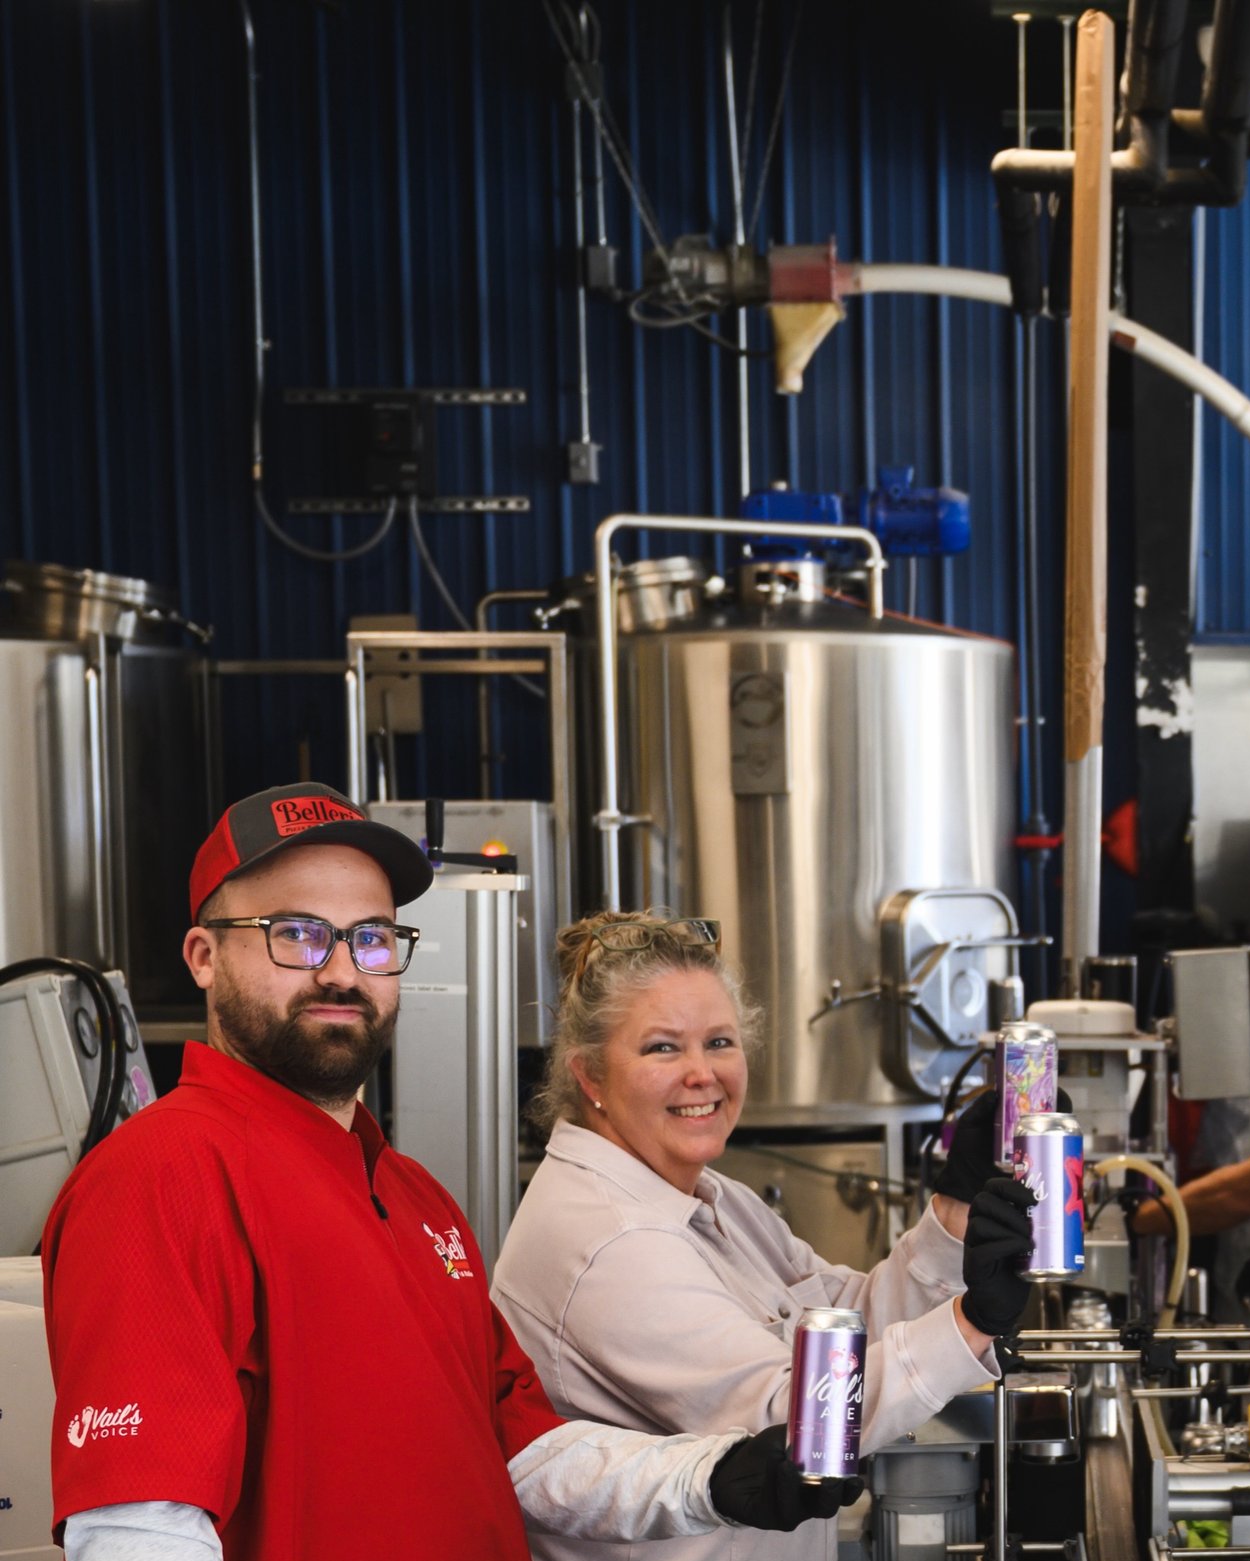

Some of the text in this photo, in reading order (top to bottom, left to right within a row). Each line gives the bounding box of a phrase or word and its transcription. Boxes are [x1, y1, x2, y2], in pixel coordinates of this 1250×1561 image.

[806, 1371, 864, 1404] Val's
[92, 1403, 144, 1431] Vail's
[820, 1406, 856, 1421] AE
[90, 1426, 139, 1441] VOICE
